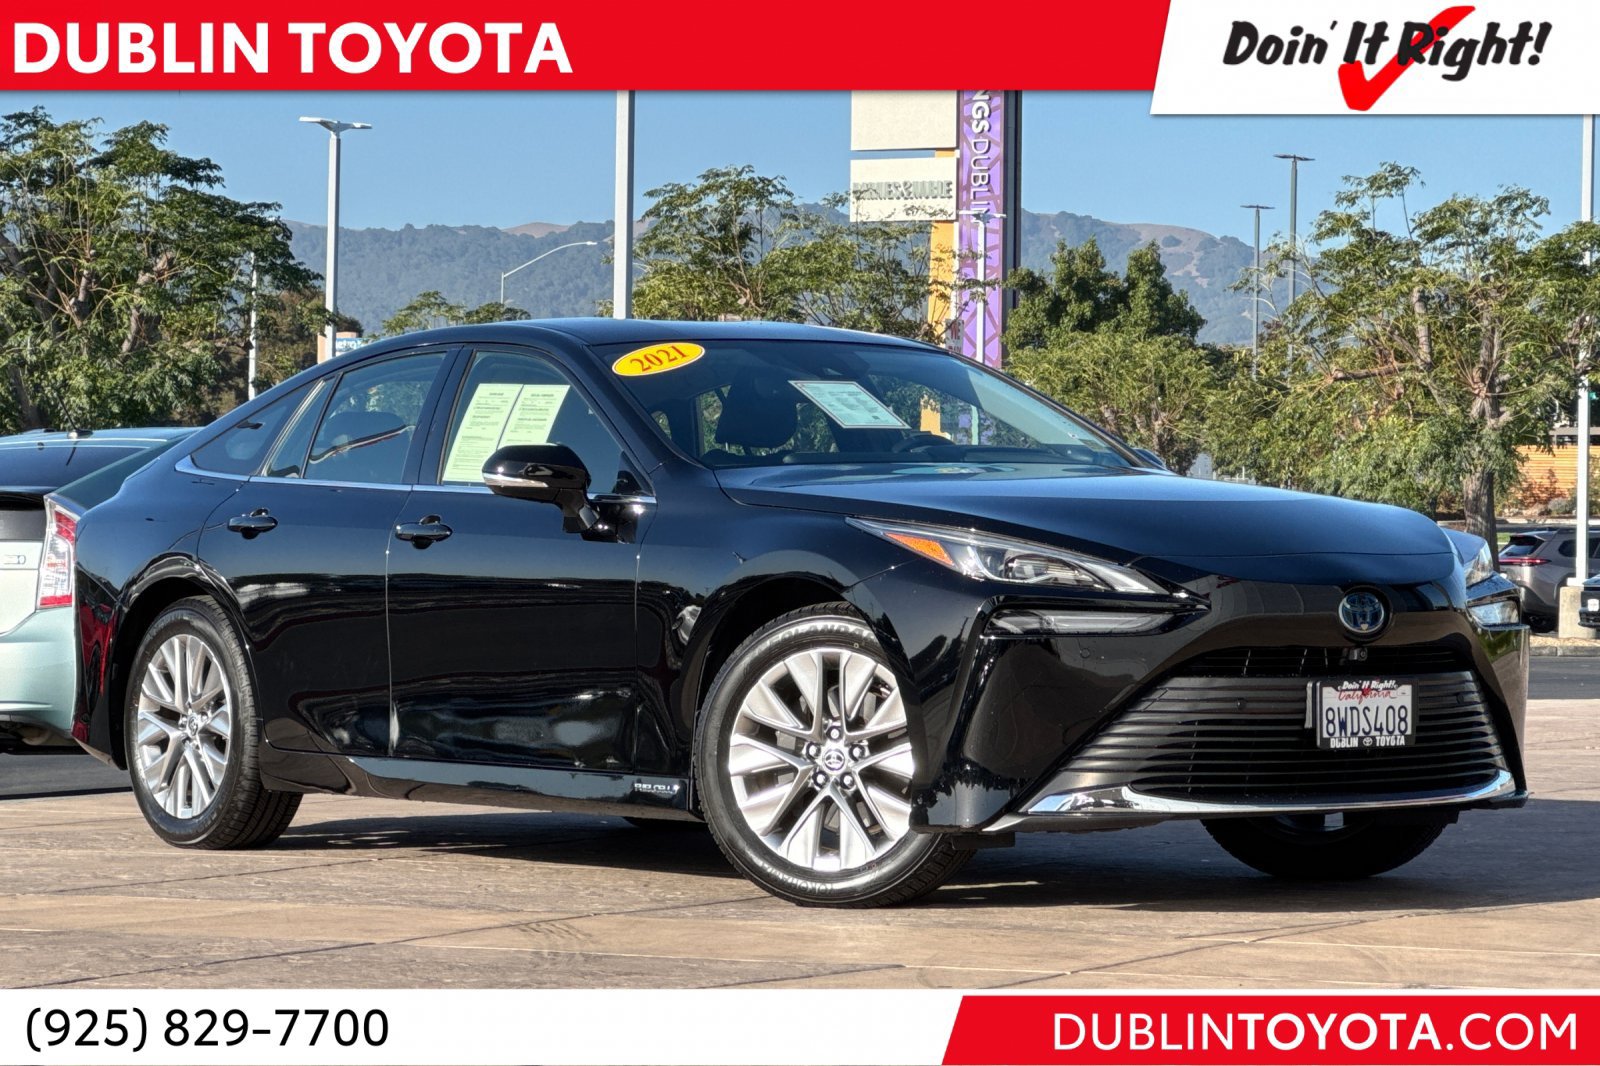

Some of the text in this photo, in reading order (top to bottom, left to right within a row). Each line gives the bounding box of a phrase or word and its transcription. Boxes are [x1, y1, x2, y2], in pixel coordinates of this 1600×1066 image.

[630, 345, 688, 372] 2021
[1325, 705, 1408, 737] 8WDS408
[1330, 735, 1405, 748] DUBLIN TOYOTA
